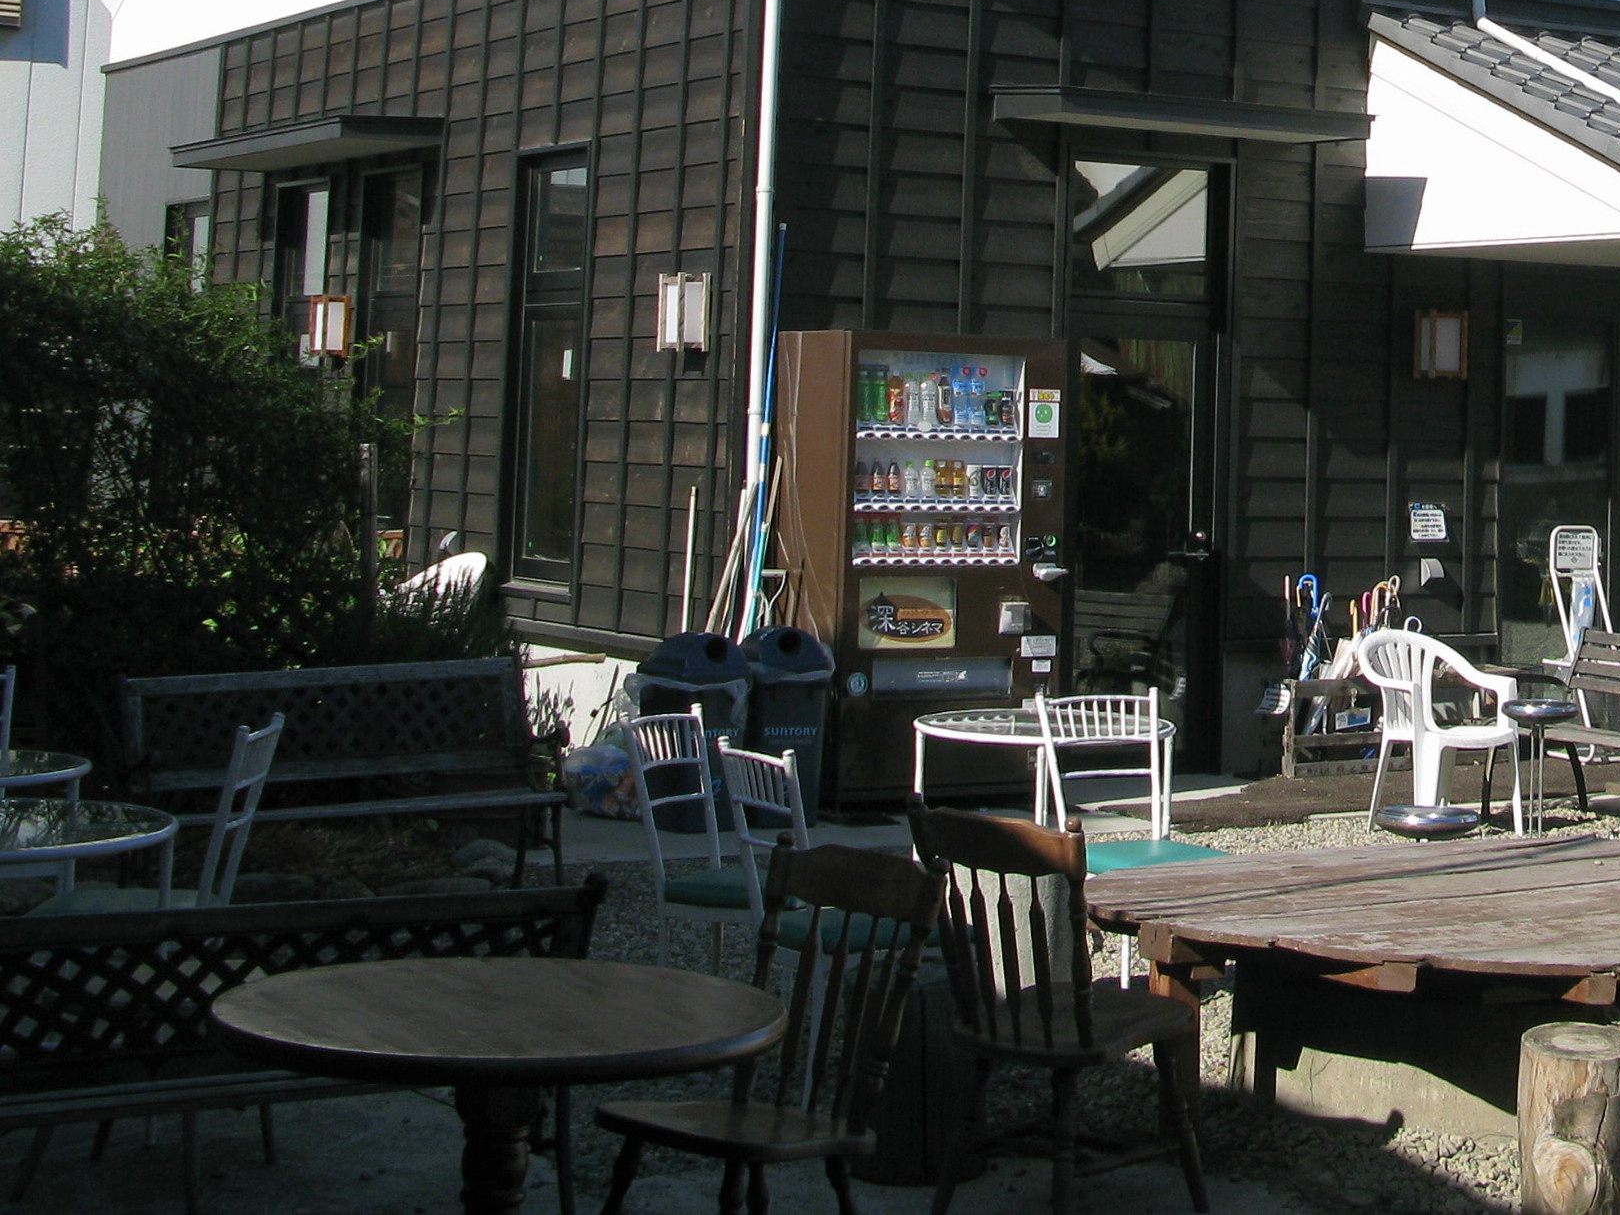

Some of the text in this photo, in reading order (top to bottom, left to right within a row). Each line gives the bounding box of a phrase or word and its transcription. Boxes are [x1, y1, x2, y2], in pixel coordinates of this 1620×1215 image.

[869, 604, 944, 635] 深谷シネマ
[763, 726, 818, 737] SUNTORY
